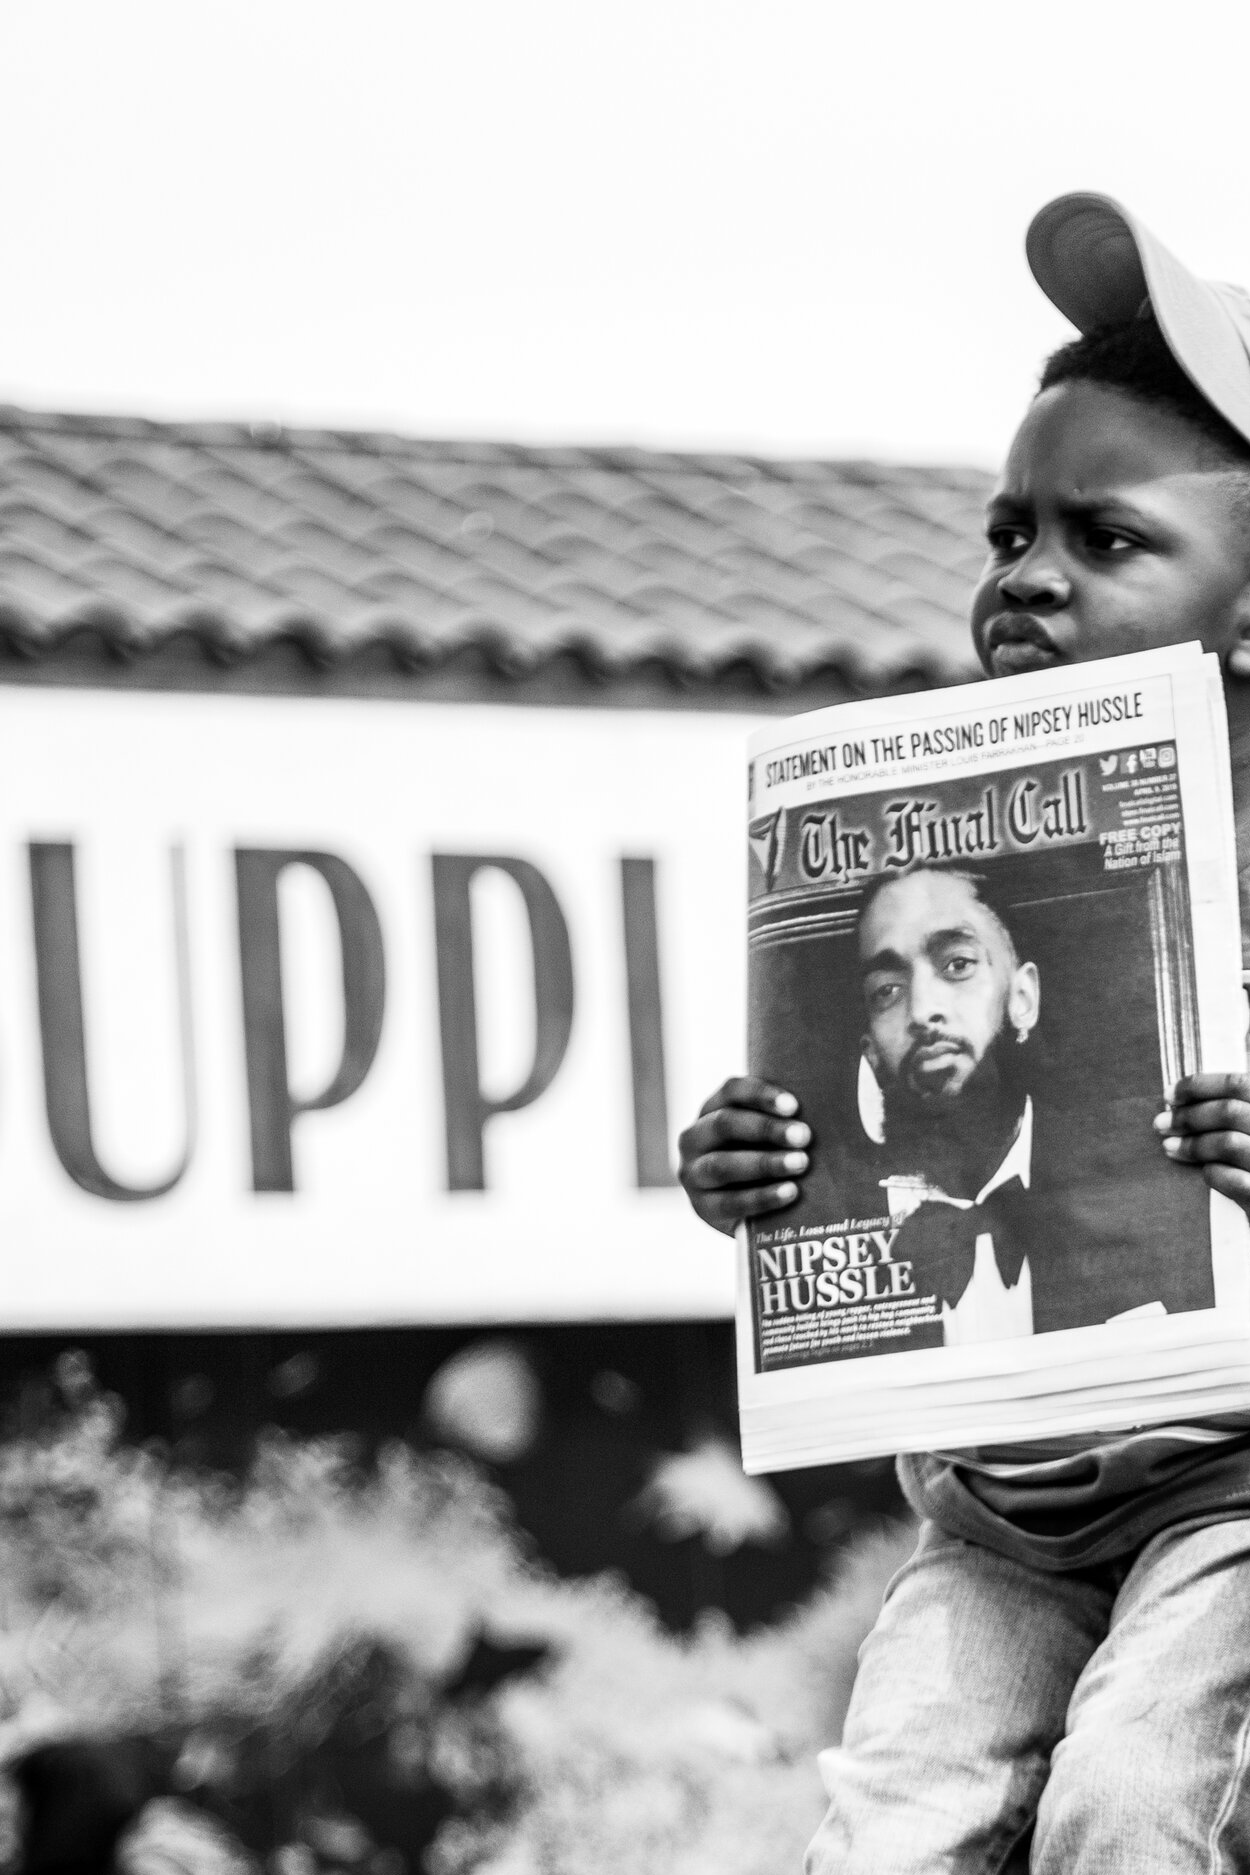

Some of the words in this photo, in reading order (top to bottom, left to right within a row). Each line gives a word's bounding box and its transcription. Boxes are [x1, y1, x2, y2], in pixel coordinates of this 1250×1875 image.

[766, 745, 837, 788] STATEMENT
[842, 740, 866, 768] ON
[871, 735, 906, 763] THE
[911, 722, 984, 758] PASSING
[989, 717, 1009, 744] OF
[1014, 704, 1073, 740] NIPSEY
[1078, 692, 1144, 728] HUSSLE
[818, 777, 835, 787] THE
[837, 767, 898, 783] HONORABLE
[901, 759, 948, 774] MINISTER
[952, 754, 979, 766] LOUIS
[801, 812, 870, 880] The
[885, 787, 999, 868] Final
[1008, 771, 1087, 844] Call
[1099, 828, 1138, 845] FREE
[1140, 821, 1181, 840] COPY
[1104, 844, 1113, 858] A
[1114, 841, 1135, 856] Gift
[1135, 838, 1160, 853] from
[1161, 836, 1180, 850] the
[1104, 856, 1138, 870] Nation
[1140, 851, 1152, 865] of
[1152, 849, 1181, 863] Islam
[825, 1218, 849, 1234] and
[757, 1228, 900, 1281] NIPSEY
[760, 1260, 916, 1315] HUSSLE
